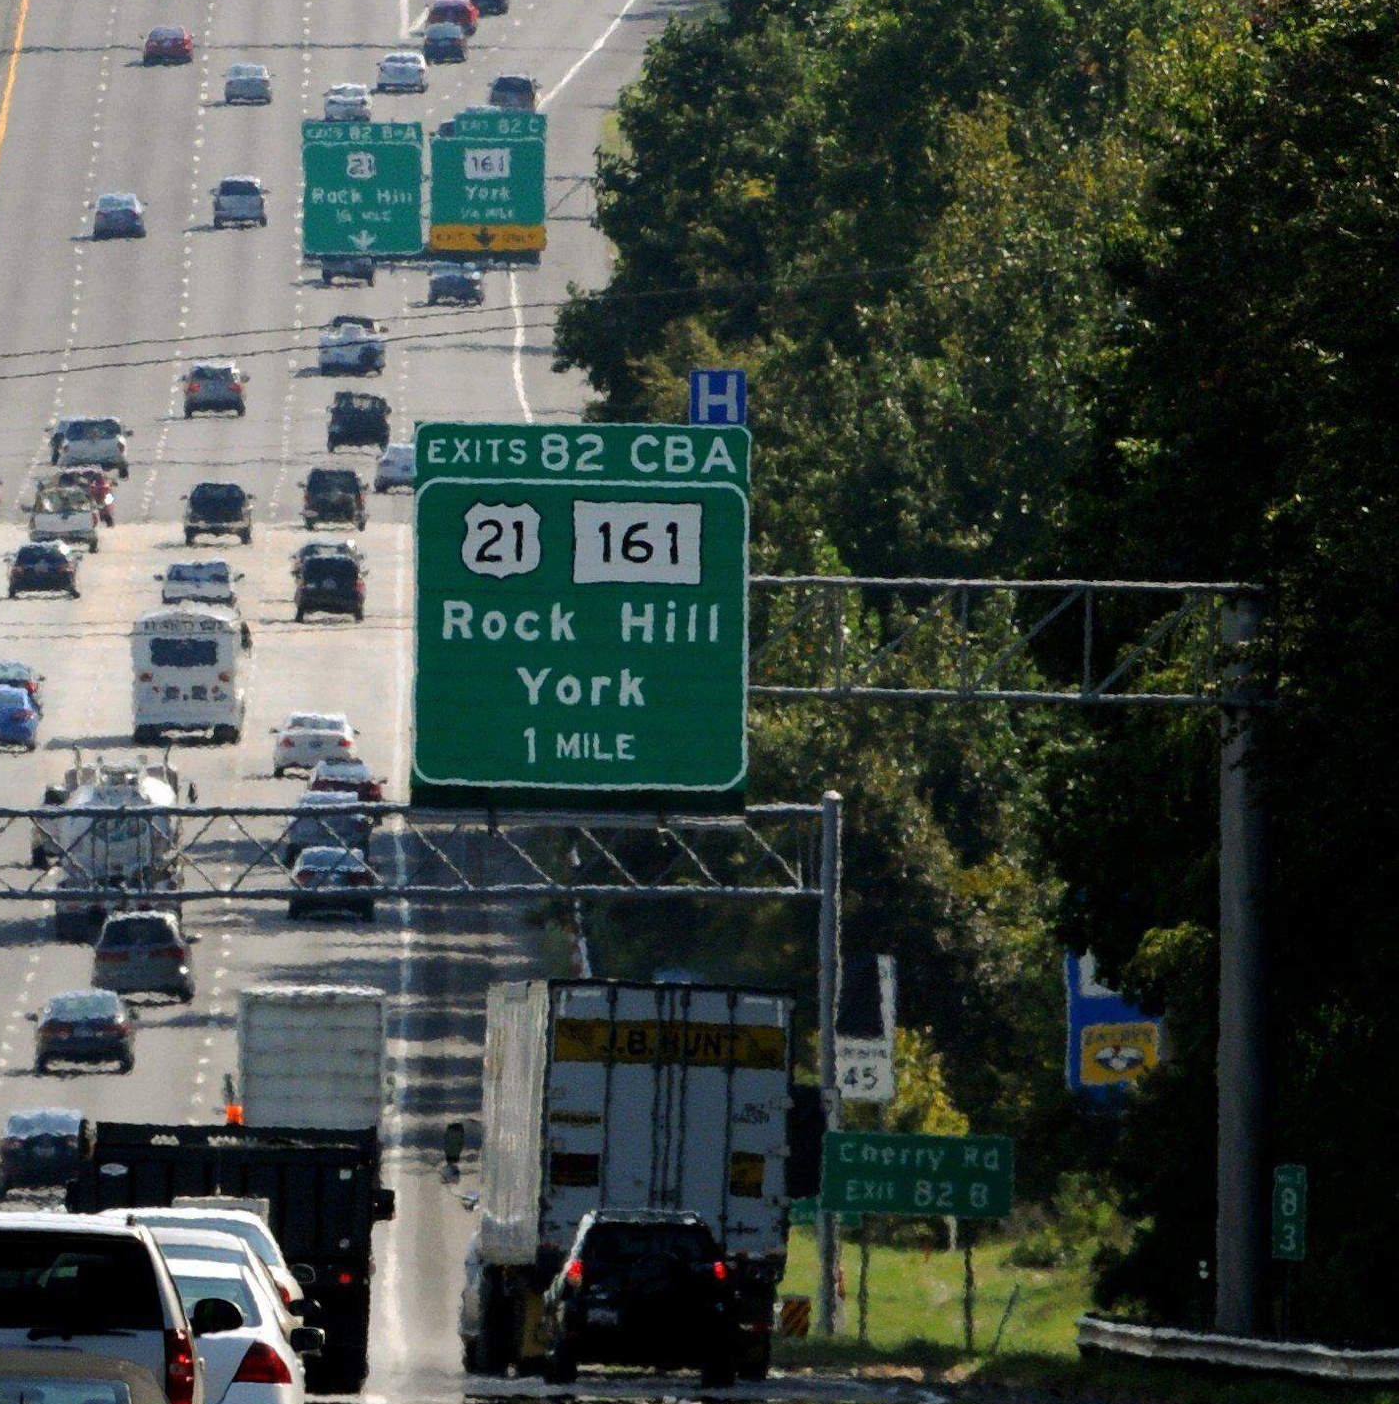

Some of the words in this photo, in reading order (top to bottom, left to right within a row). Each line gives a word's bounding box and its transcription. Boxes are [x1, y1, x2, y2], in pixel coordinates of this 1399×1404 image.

[304, 127, 344, 141] EXITS
[349, 125, 373, 142] 82
[382, 125, 418, 141] B-A
[460, 119, 489, 131] EXIT
[498, 118, 522, 134] 82
[528, 118, 541, 133] C
[349, 157, 374, 176] 21
[471, 155, 506, 172] 161
[311, 186, 363, 205] Rock
[376, 188, 414, 205] Hill
[465, 185, 512, 201] York
[361, 209, 393, 222] MILE
[484, 207, 515, 220] MILE
[436, 231, 466, 243] EXIT
[502, 231, 536, 243] ONLY
[700, 374, 739, 422] H
[427, 438, 526, 465] EXITS
[540, 433, 605, 471] 82
[630, 434, 737, 474] CBA
[475, 518, 524, 564] 21
[598, 522, 679, 565] 161
[442, 600, 576, 642] Rock
[620, 600, 719, 644] Hill
[516, 666, 646, 707] York
[522, 726, 538, 764] 1
[556, 732, 636, 761] MILE
[659, 1030, 740, 1059] HUNT
[843, 1066, 879, 1090] 45
[839, 1142, 946, 1172] Cherry
[963, 1145, 1000, 1172] Rd
[914, 1179, 953, 1208] 82
